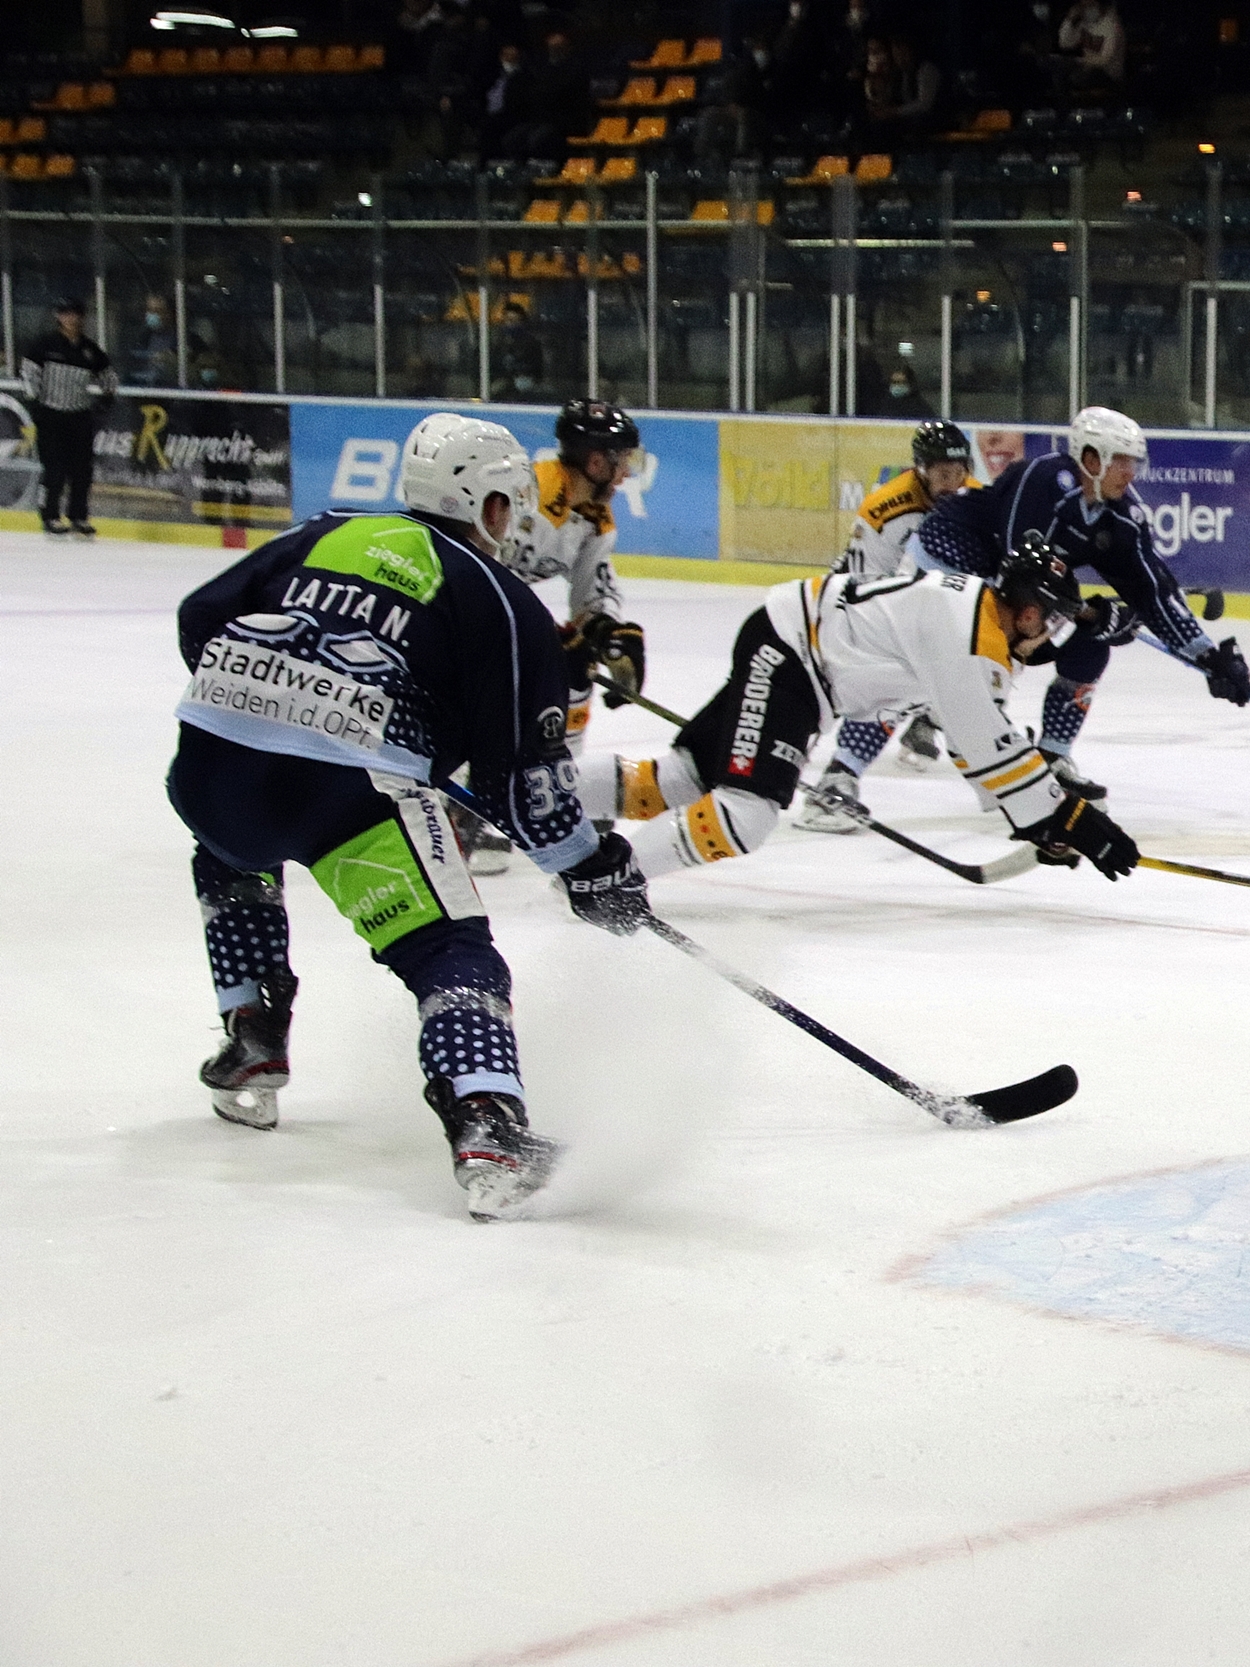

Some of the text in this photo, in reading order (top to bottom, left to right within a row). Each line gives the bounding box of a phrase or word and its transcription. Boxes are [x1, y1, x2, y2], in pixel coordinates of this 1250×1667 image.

[374, 562, 421, 592] haus
[281, 577, 410, 648] LATTA N.
[190, 677, 281, 718] Weiden
[199, 641, 386, 723] Stadtwerke
[359, 899, 411, 935] haus
